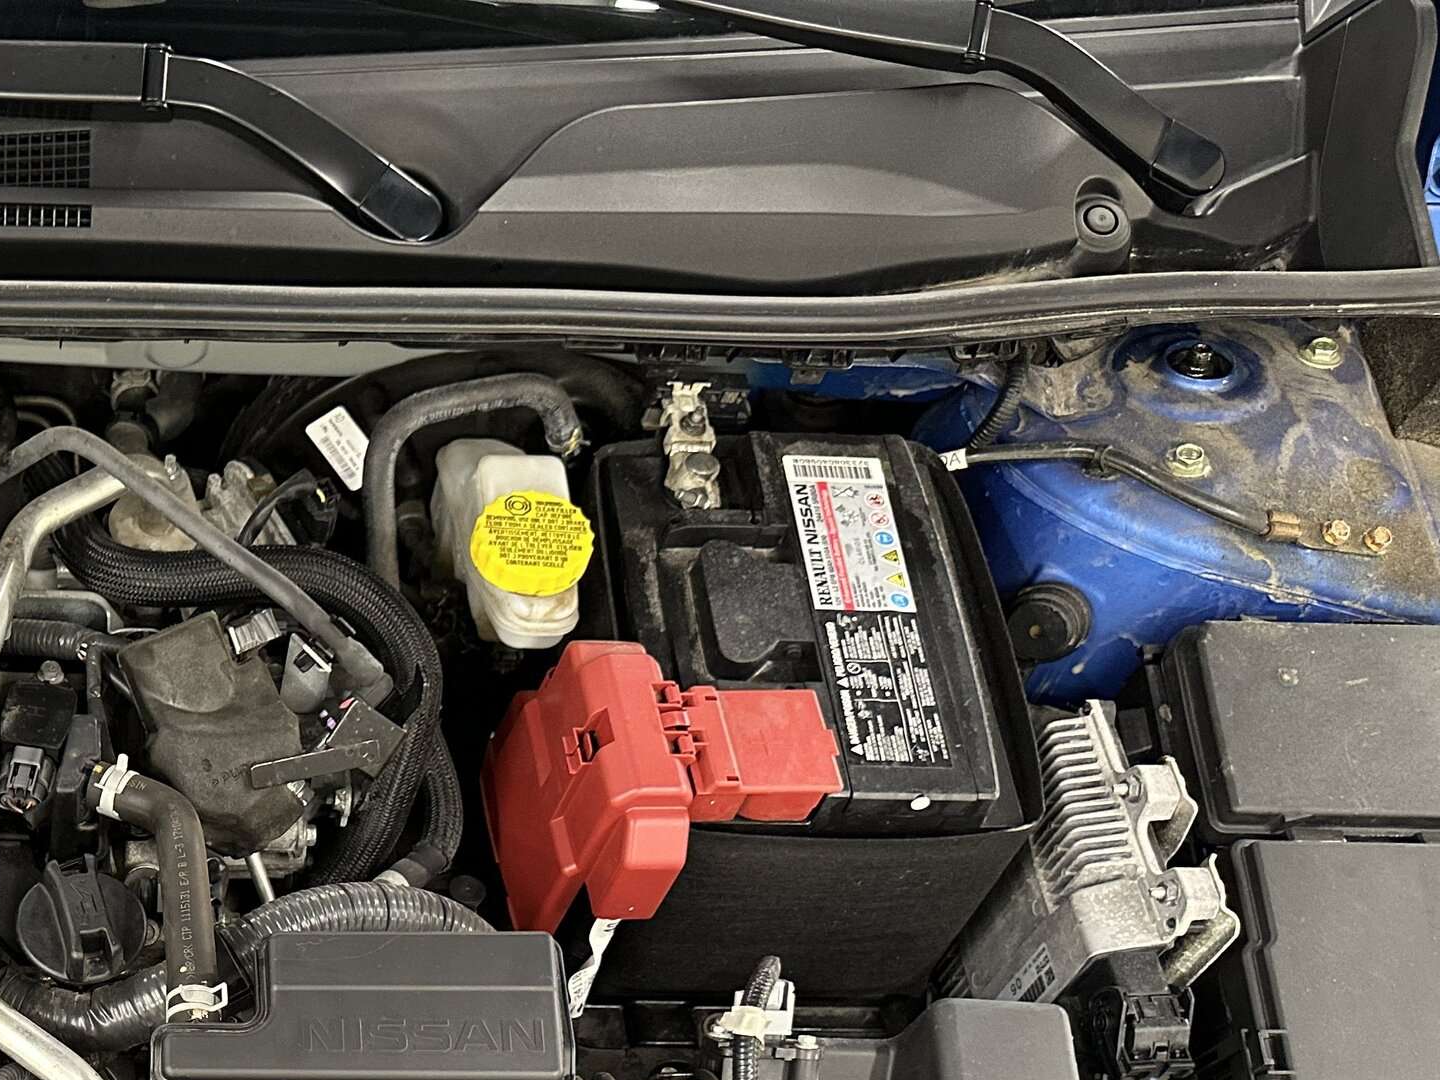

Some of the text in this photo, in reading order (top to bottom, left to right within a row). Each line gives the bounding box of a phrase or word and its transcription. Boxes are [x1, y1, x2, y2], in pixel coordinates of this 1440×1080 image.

[794, 484, 833, 605] RENAULT NISSAN
[182, 926, 192, 941] CTP
[301, 1017, 546, 1053] NISSAN
